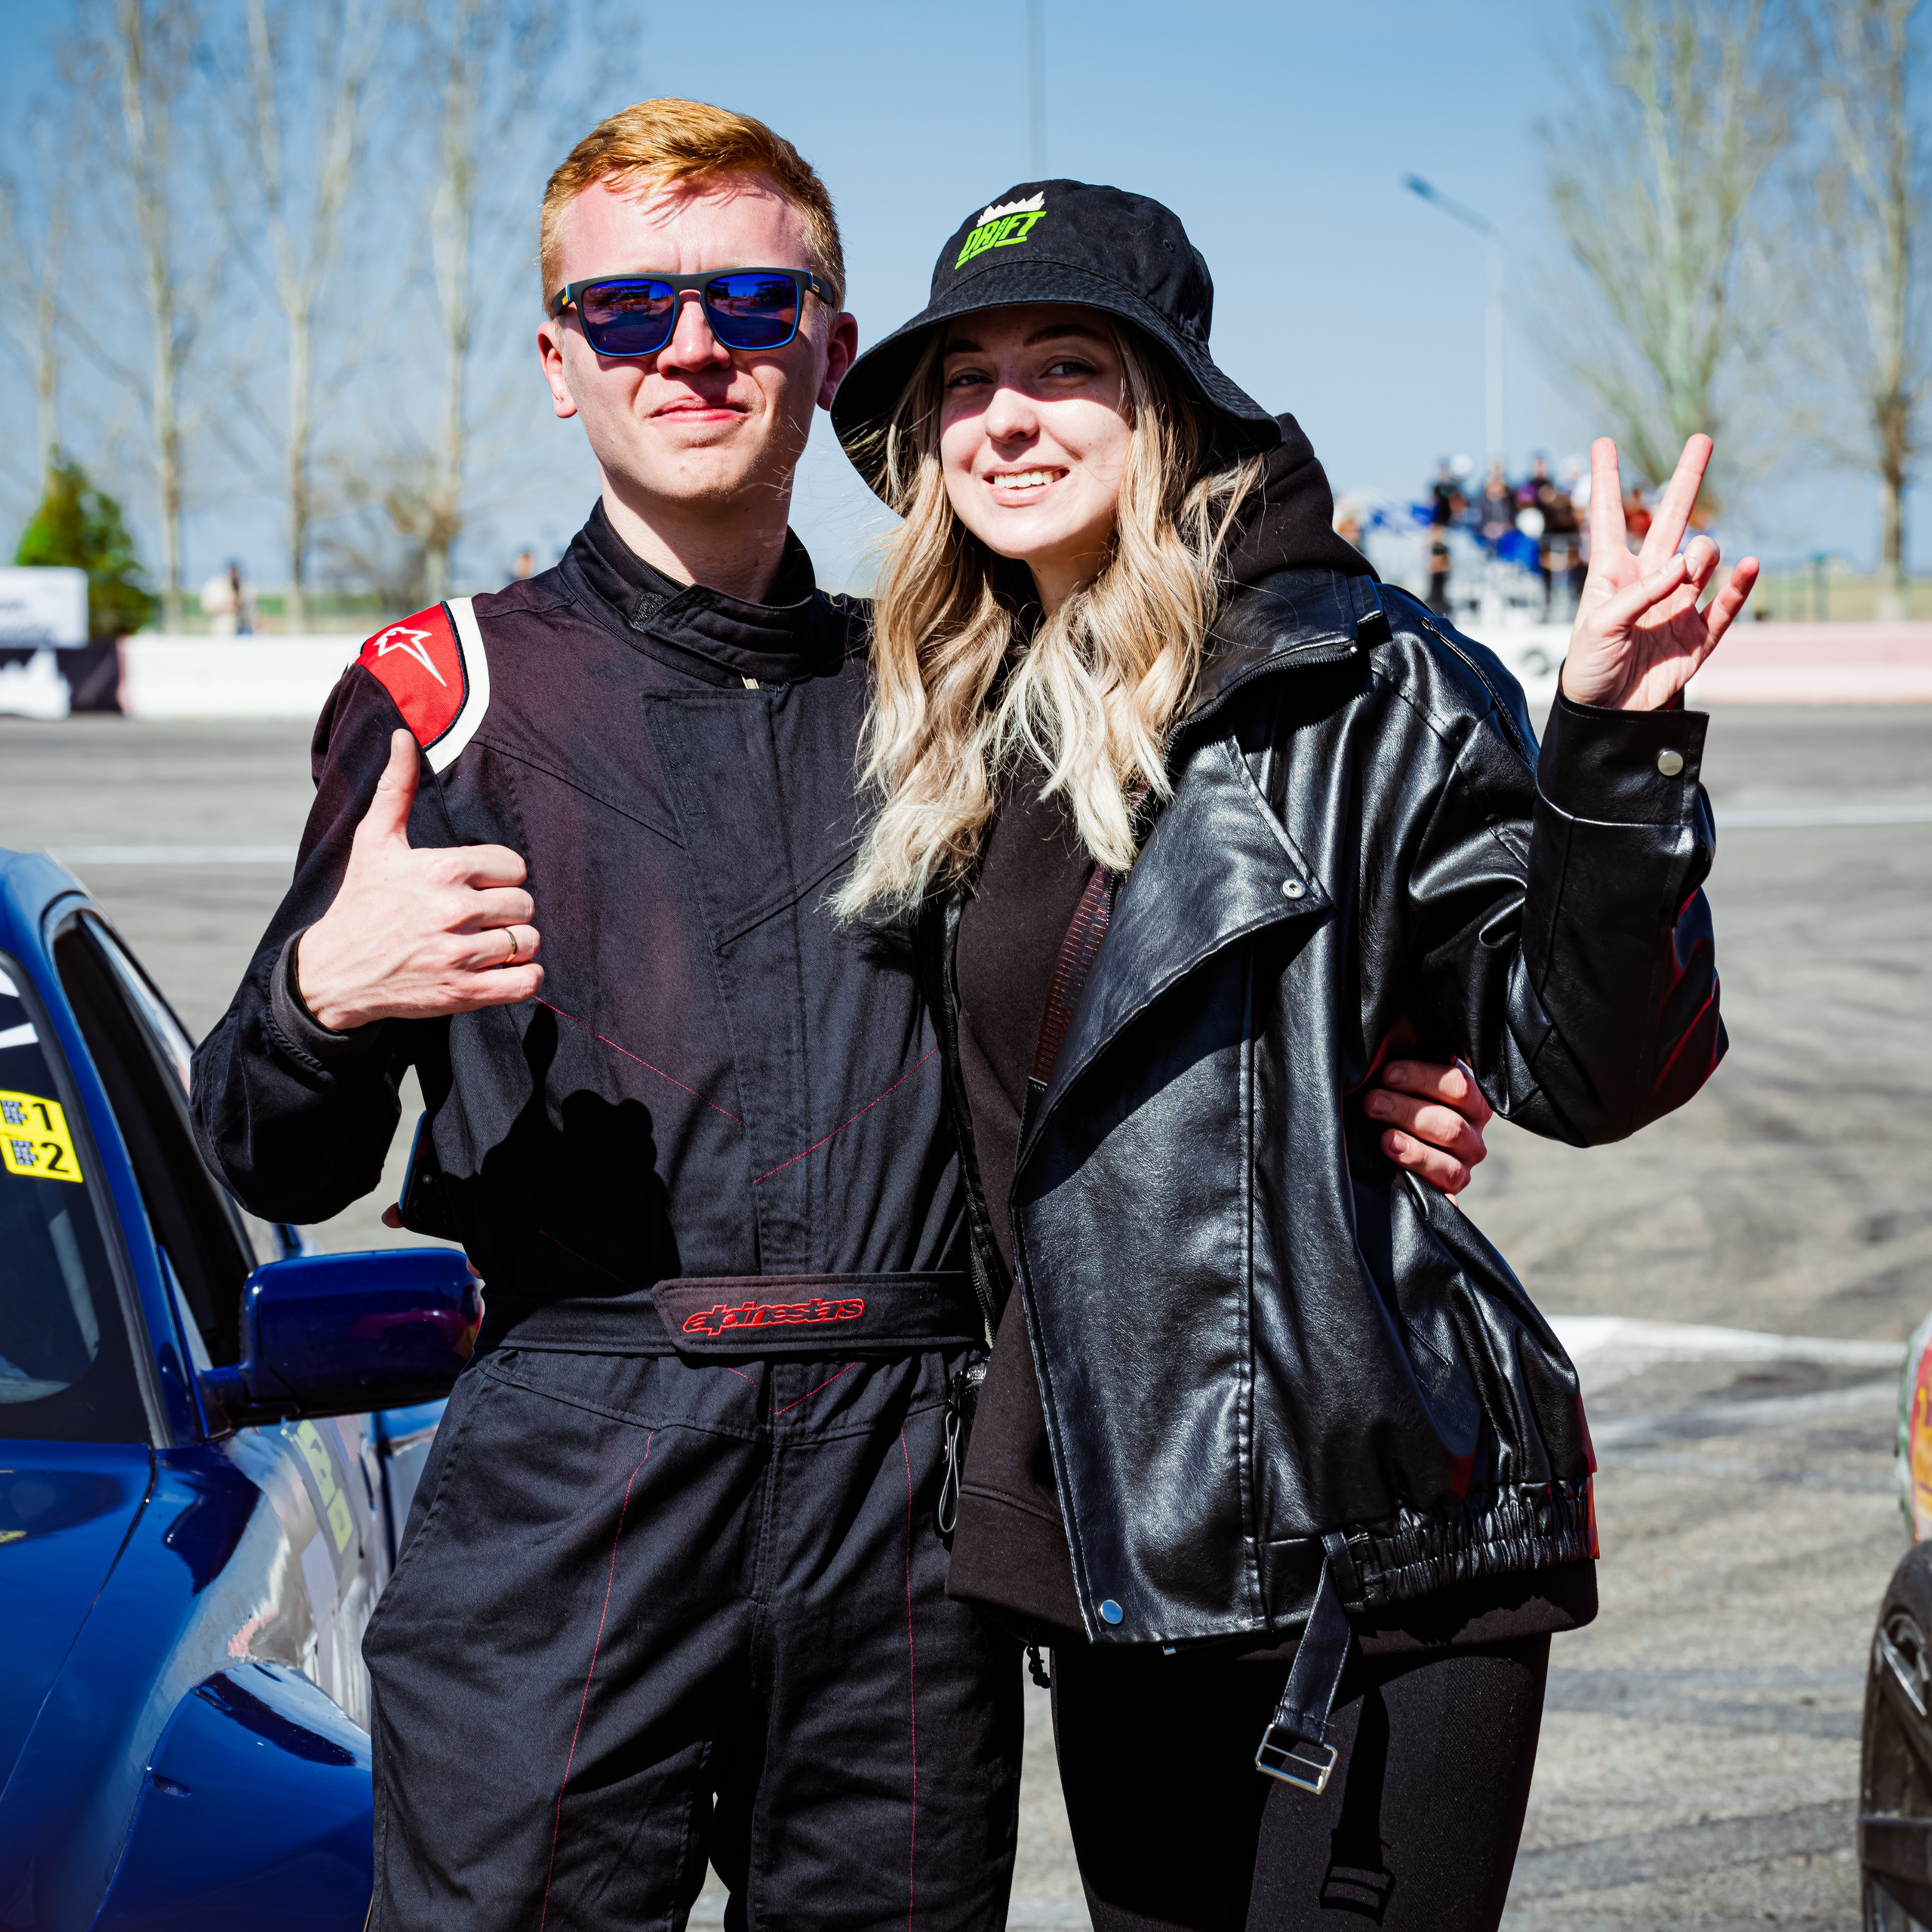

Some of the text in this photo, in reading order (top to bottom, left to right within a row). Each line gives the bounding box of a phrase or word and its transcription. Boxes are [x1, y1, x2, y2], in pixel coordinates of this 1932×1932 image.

[955, 211, 1047, 269] DRIFT
[32, 1103, 53, 1131] 1
[41, 1142, 69, 1173] 2
